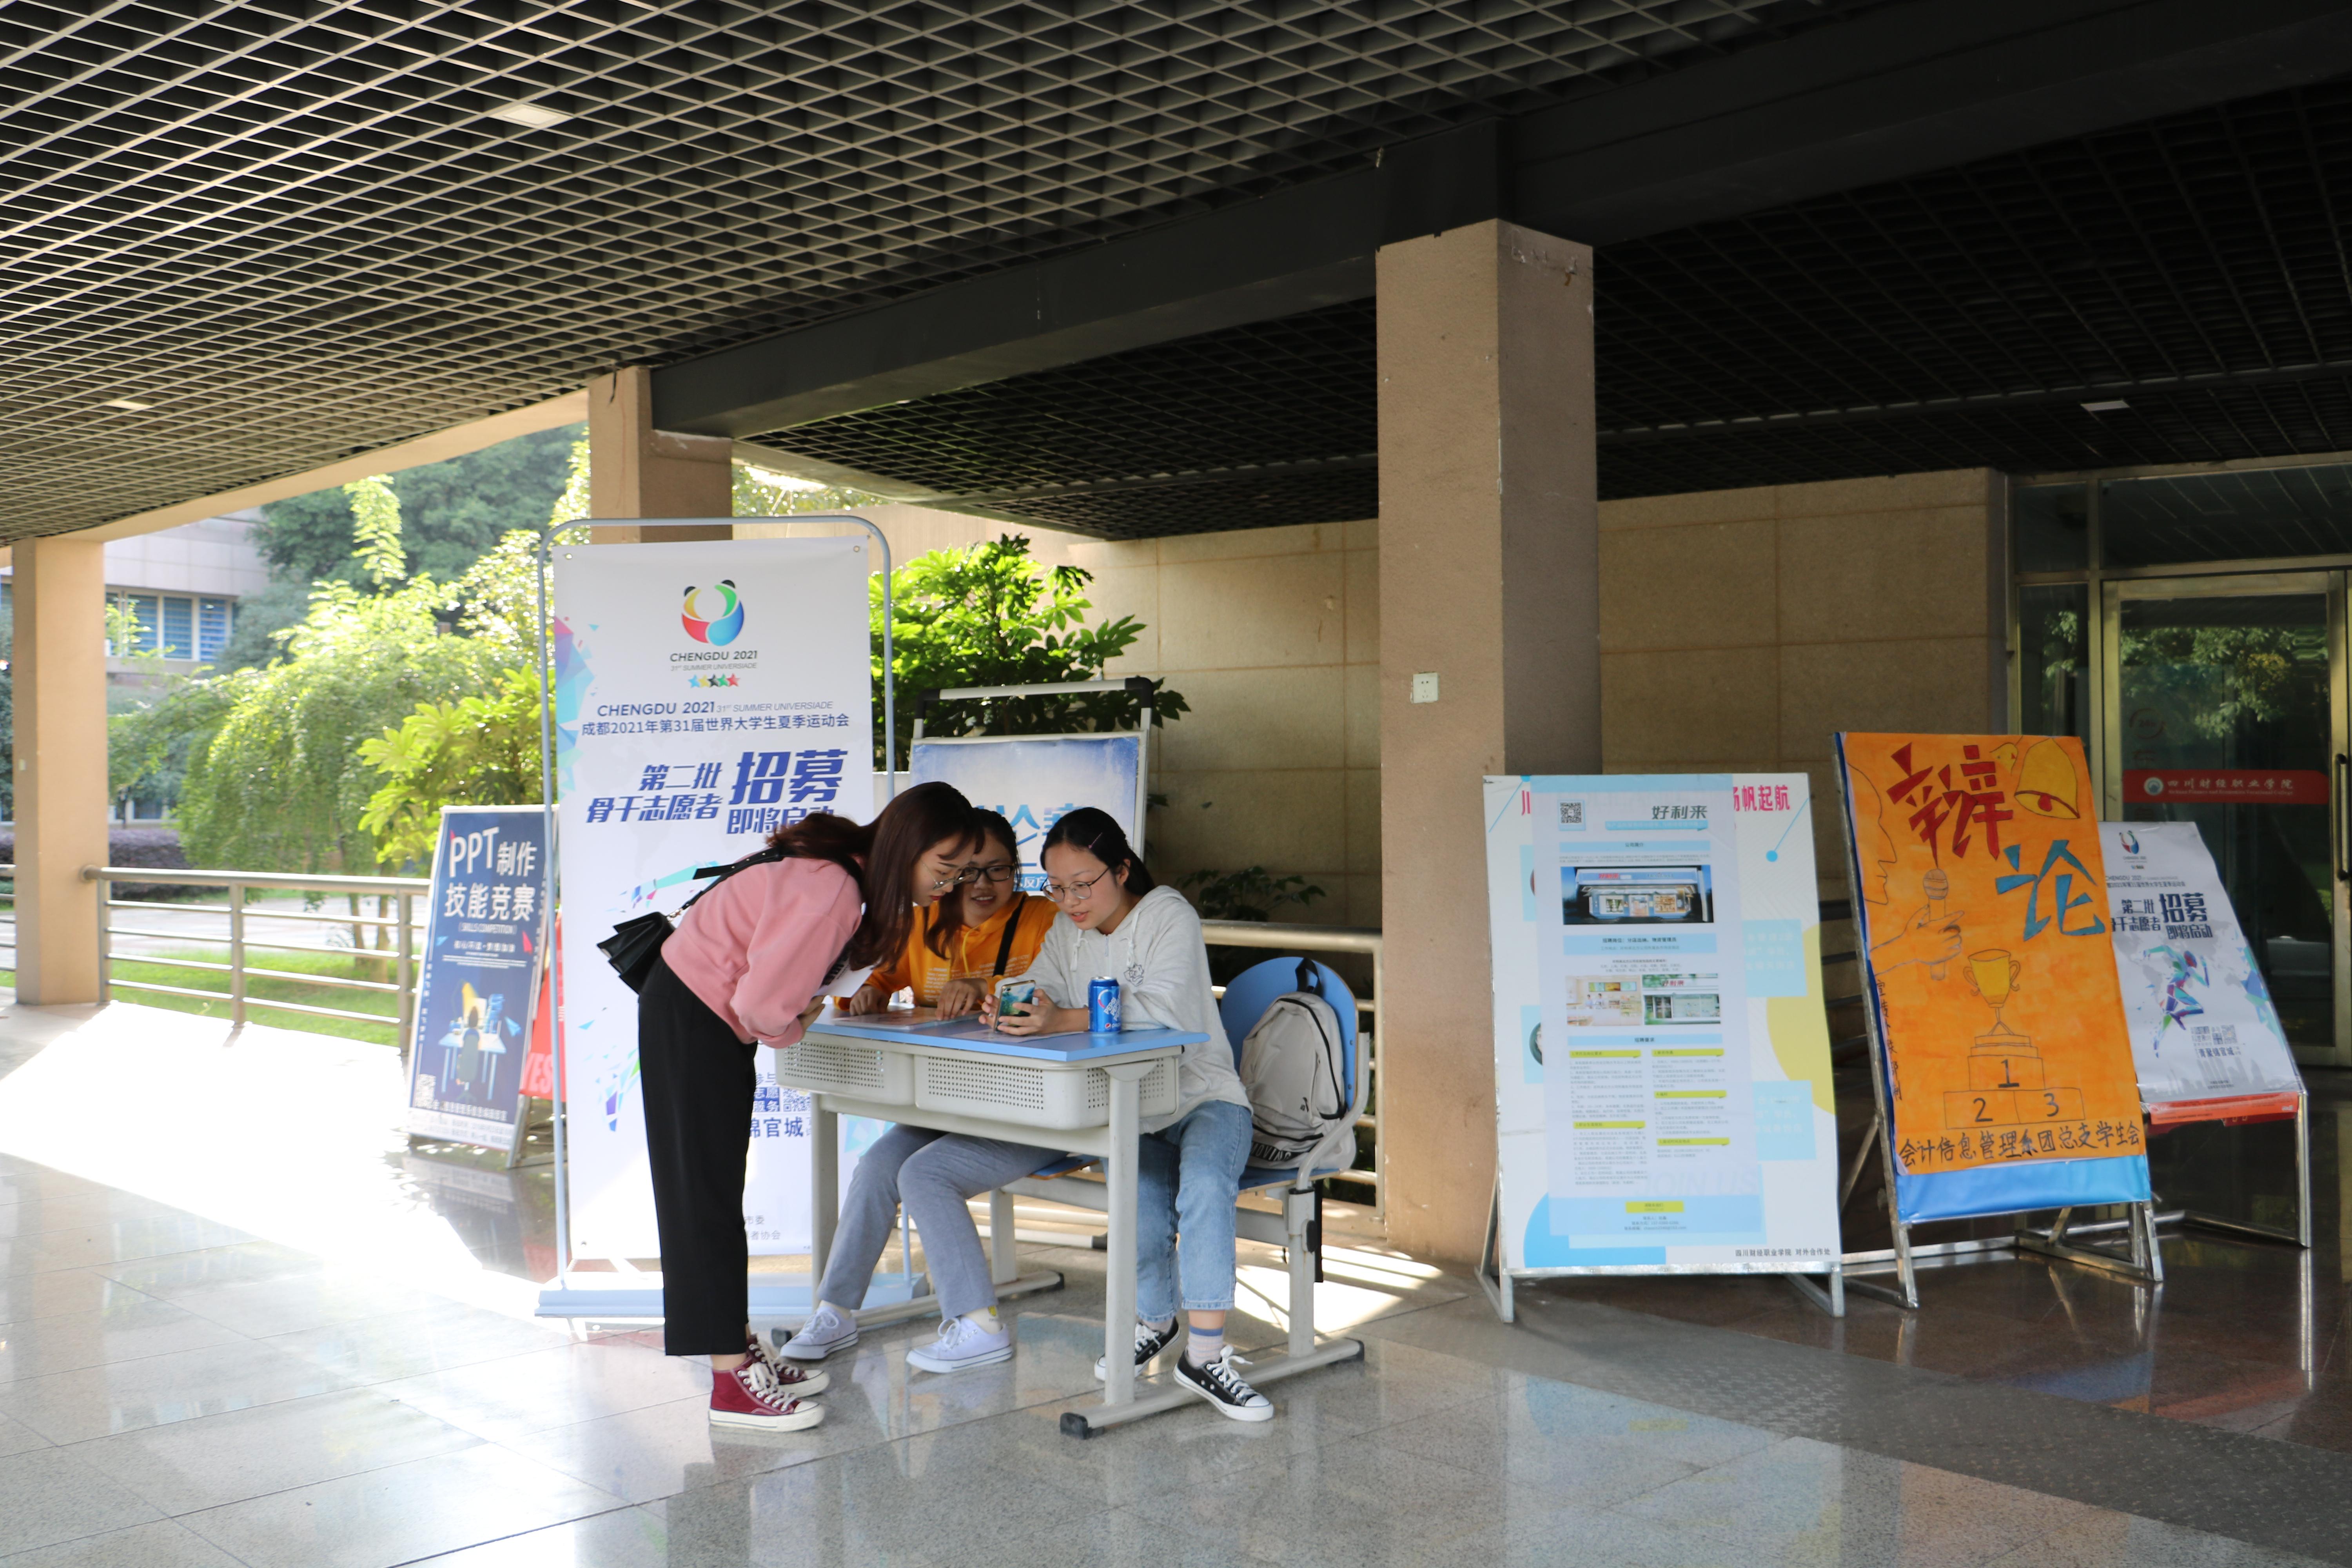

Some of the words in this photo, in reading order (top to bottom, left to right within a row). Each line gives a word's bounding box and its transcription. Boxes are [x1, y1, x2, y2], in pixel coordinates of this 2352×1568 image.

[670, 652, 730, 662] CHENGDU
[733, 650, 758, 660] 2021
[597, 703, 677, 717] CHENGDU
[682, 701, 716, 714] 2021
[733, 703, 773, 712] SUMMER
[773, 701, 833, 710] UNIVERSIADE
[582, 713, 849, 736] 成都2021年第31届世界大学生夏季运动会
[639, 762, 722, 791] 第二批
[728, 749, 848, 805] 招募
[586, 793, 723, 823] 骨干志愿者
[726, 805, 834, 834] 即将启
[1651, 805, 1708, 820] 好利来
[444, 881, 535, 922] 技能竞赛
[2121, 899, 2155, 914] 第二批
[2159, 893, 2207, 923] 招募
[2166, 924, 2213, 940] 即将启动
[1998, 1059, 2019, 1088] 1
[1973, 1098, 1993, 1123] 2
[2043, 1093, 2059, 1117] 3
[747, 1230, 780, 1241] 者协会
[1735, 1248, 1791, 1257] 四川财经职业学院
[1795, 1248, 1830, 1256] 对外合作处
